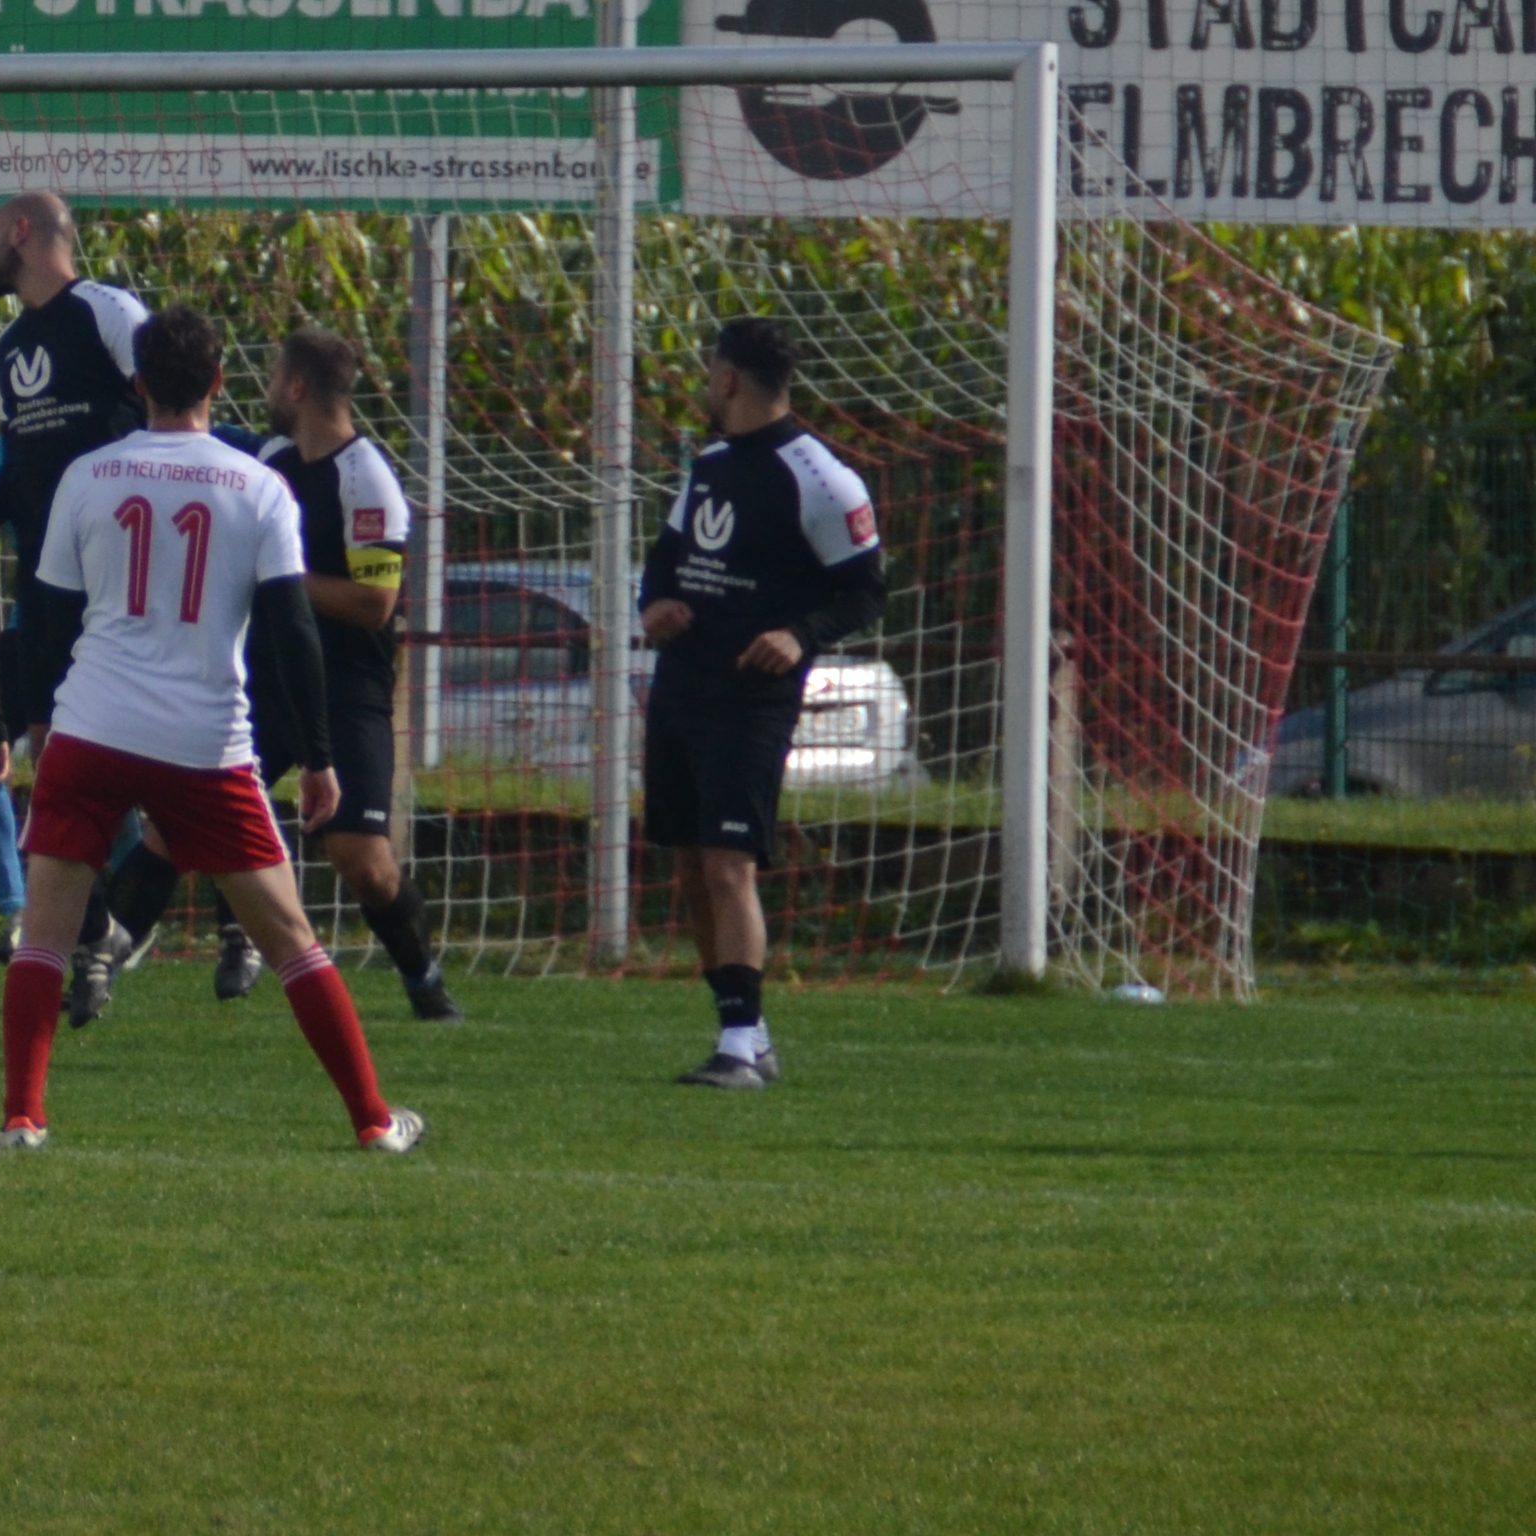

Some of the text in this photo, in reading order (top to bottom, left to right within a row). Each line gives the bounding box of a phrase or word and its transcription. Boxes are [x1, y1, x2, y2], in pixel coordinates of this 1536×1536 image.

[1068, 82, 1535, 205] ELMBRECH
[92, 459, 248, 492] VfB HELMBRECHTS
[114, 494, 212, 624] 11
